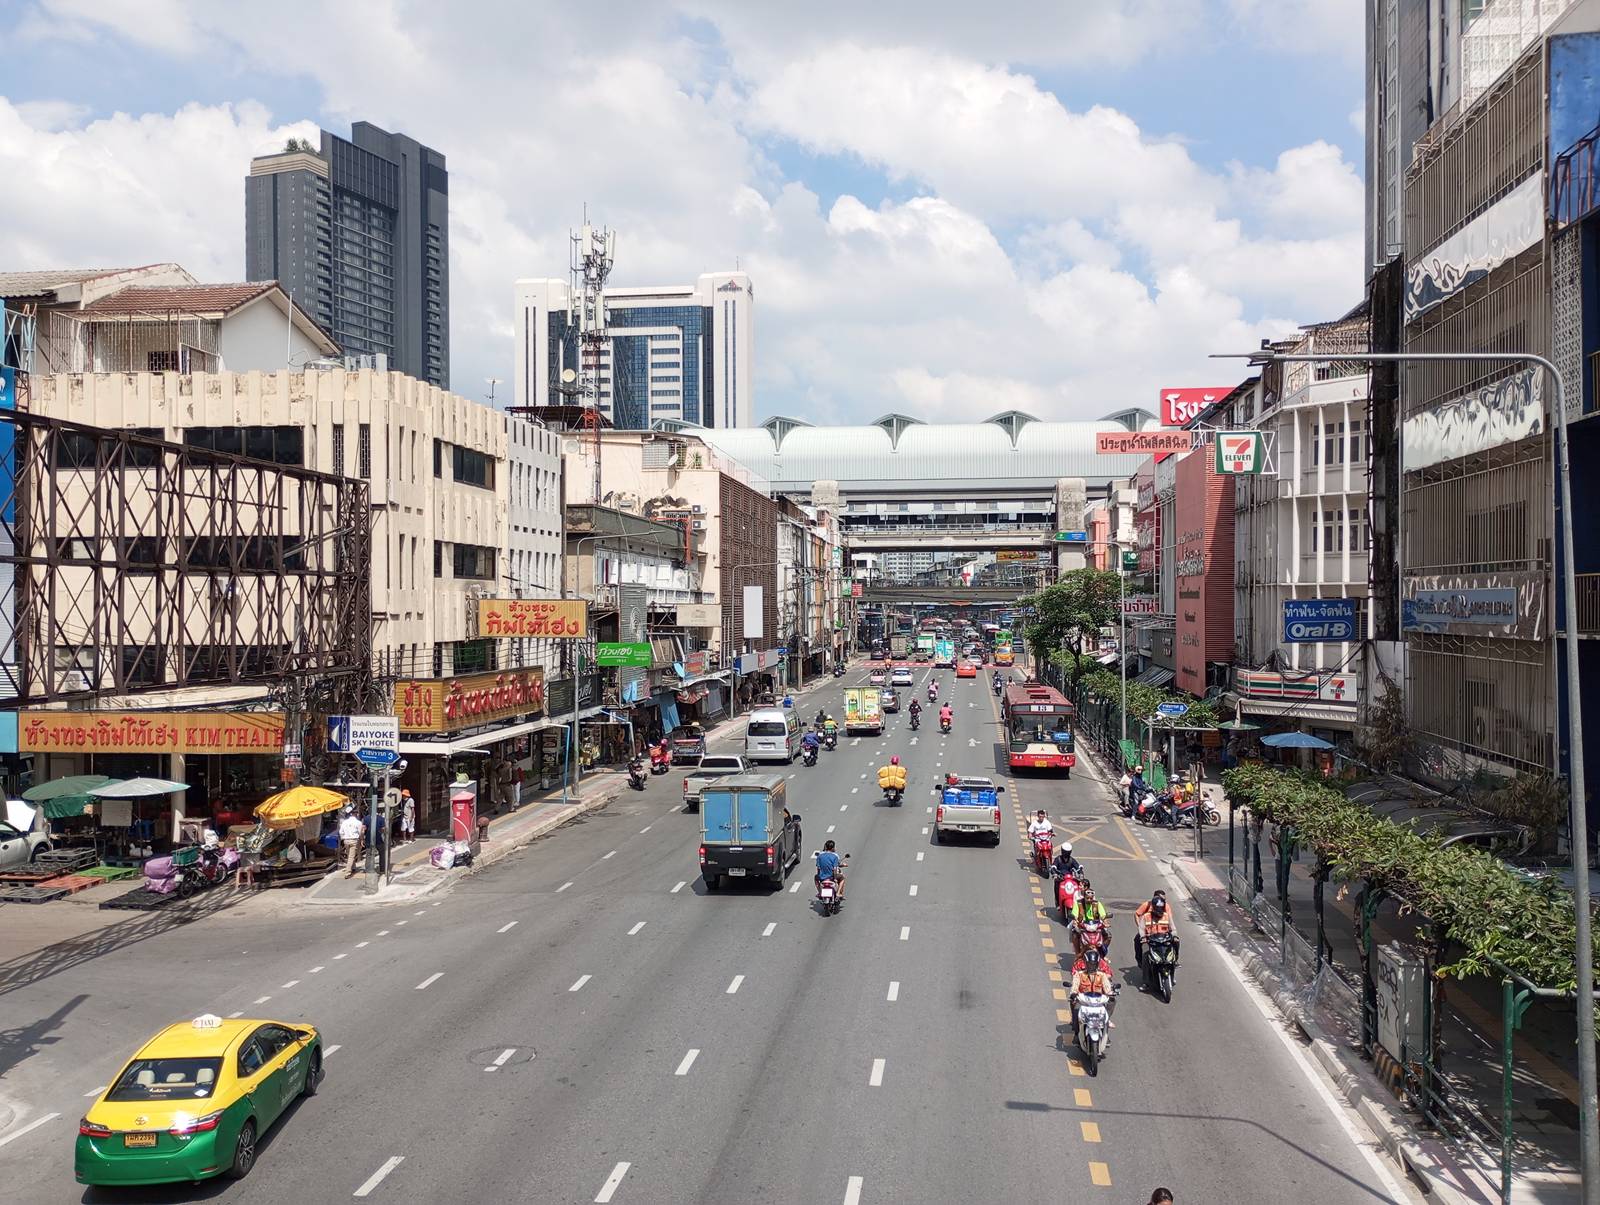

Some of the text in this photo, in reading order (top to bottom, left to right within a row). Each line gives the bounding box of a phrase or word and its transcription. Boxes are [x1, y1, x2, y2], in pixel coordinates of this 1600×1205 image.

[1226, 439, 1251, 466] 7
[509, 601, 556, 612] ห้างทอง
[1285, 604, 1353, 617] ทำฟัน-จัดฟัน
[486, 611, 580, 635] กิมไท้เฮง
[1291, 623, 1346, 637] Oral-B
[404, 680, 432, 706] ห้าง
[404, 707, 432, 727] ทอง
[185, 728, 221, 747] KIM
[224, 728, 271, 747] THAI
[388, 752, 394, 760] 3
